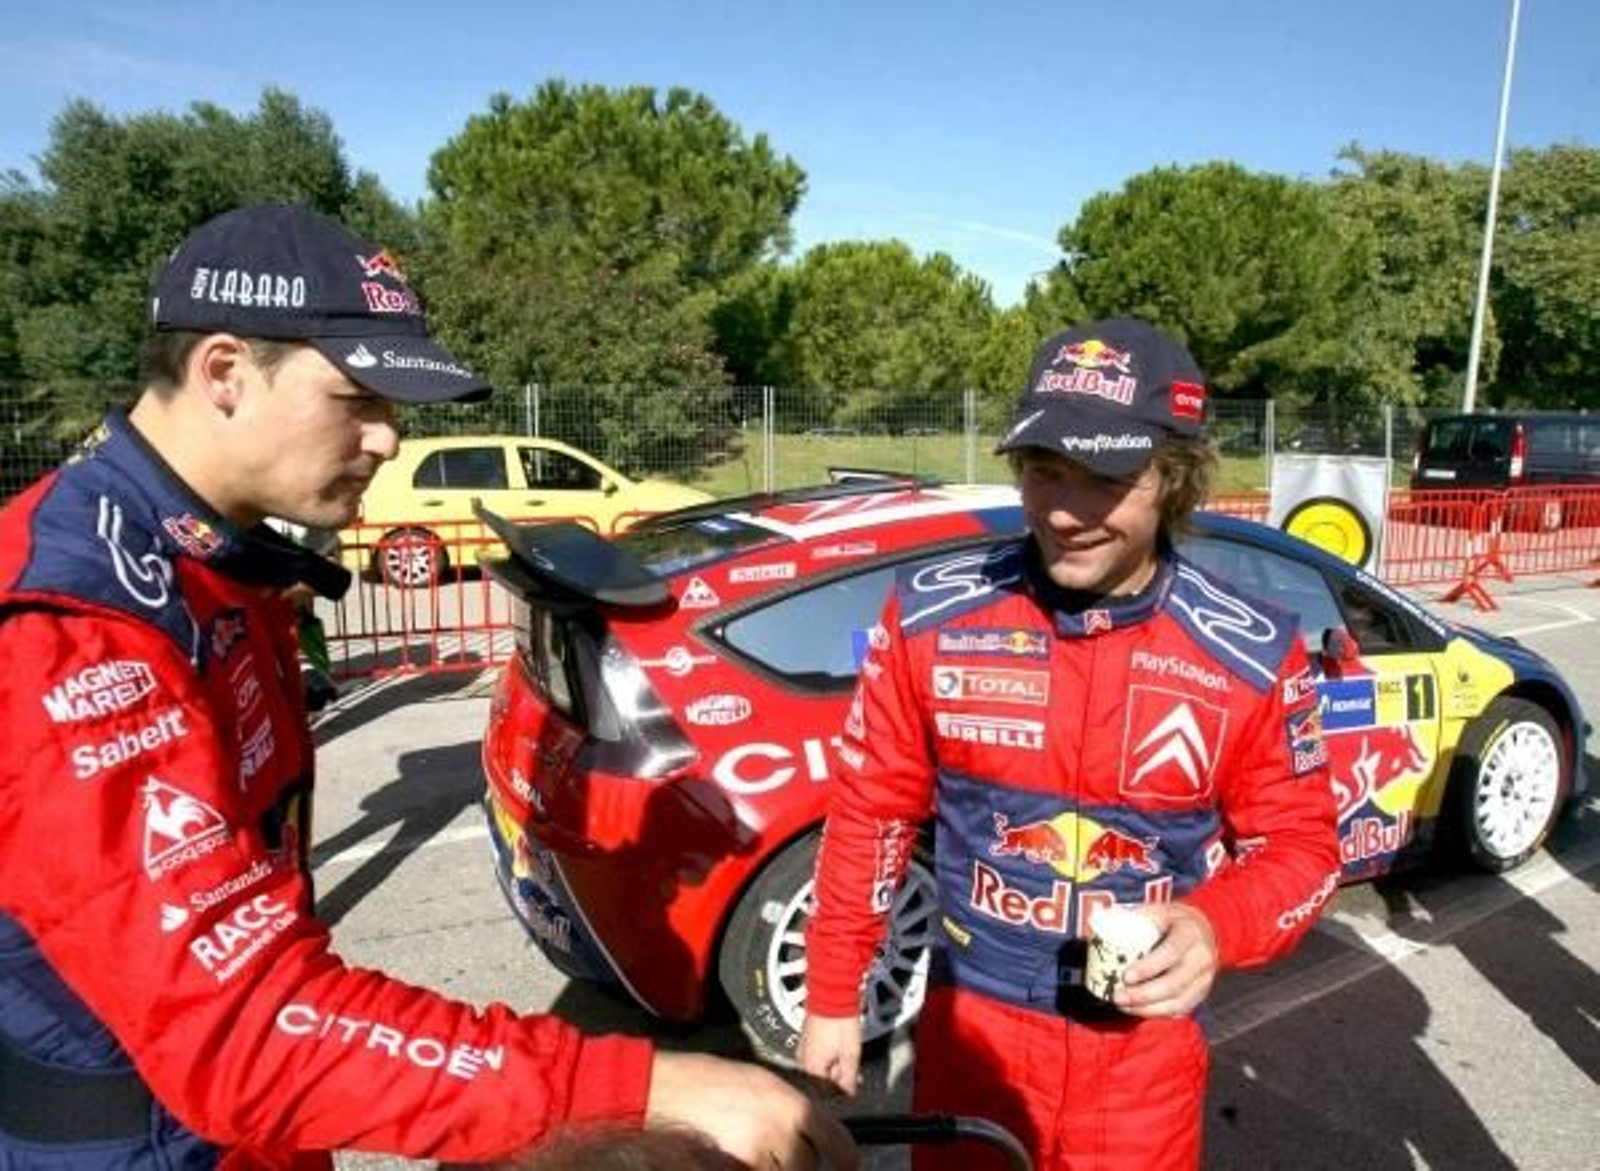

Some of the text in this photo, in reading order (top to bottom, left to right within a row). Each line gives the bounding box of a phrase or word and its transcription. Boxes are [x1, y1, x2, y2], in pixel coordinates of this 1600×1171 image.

[209, 269, 305, 307] LABARO
[964, 674, 1044, 697] TOTAL
[72, 703, 190, 779] Sabelt
[189, 894, 288, 971] RACC
[970, 860, 1072, 934] Red
[276, 1004, 504, 1080] CITROËN
